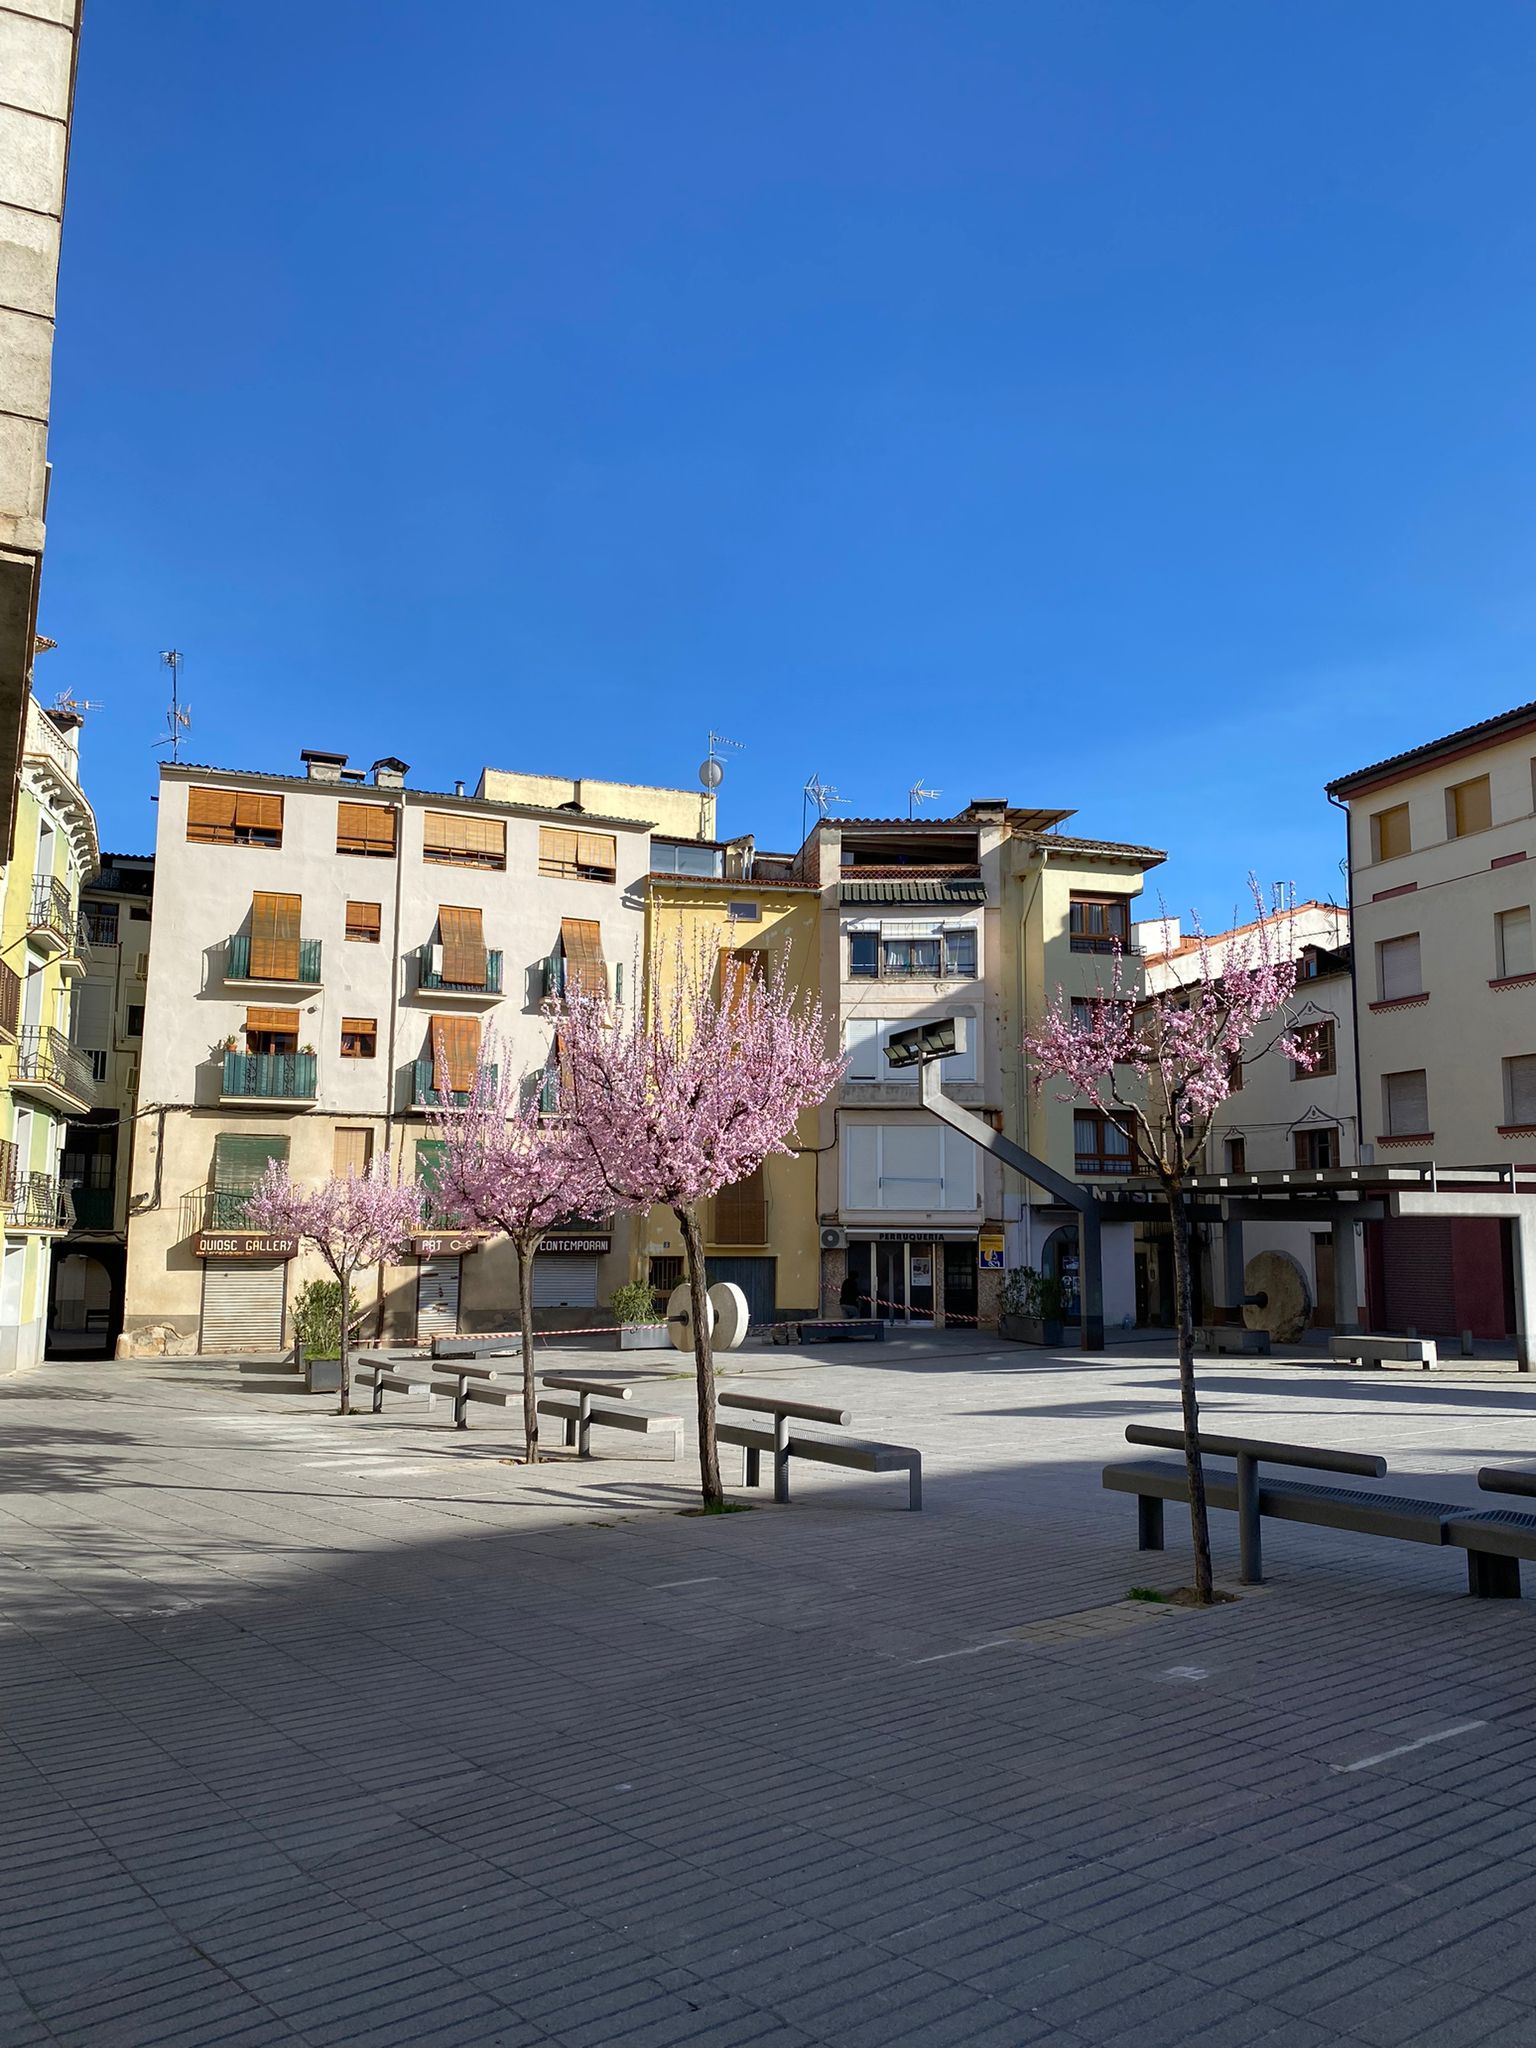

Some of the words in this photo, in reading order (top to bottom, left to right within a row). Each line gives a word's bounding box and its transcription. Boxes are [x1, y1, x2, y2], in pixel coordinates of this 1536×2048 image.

[879, 1233, 945, 1241] PERRUQUERIA
[199, 1239, 238, 1251] QUIOSC
[245, 1240, 293, 1251] GALLERY
[539, 1240, 609, 1251] CONTEMPORANI
